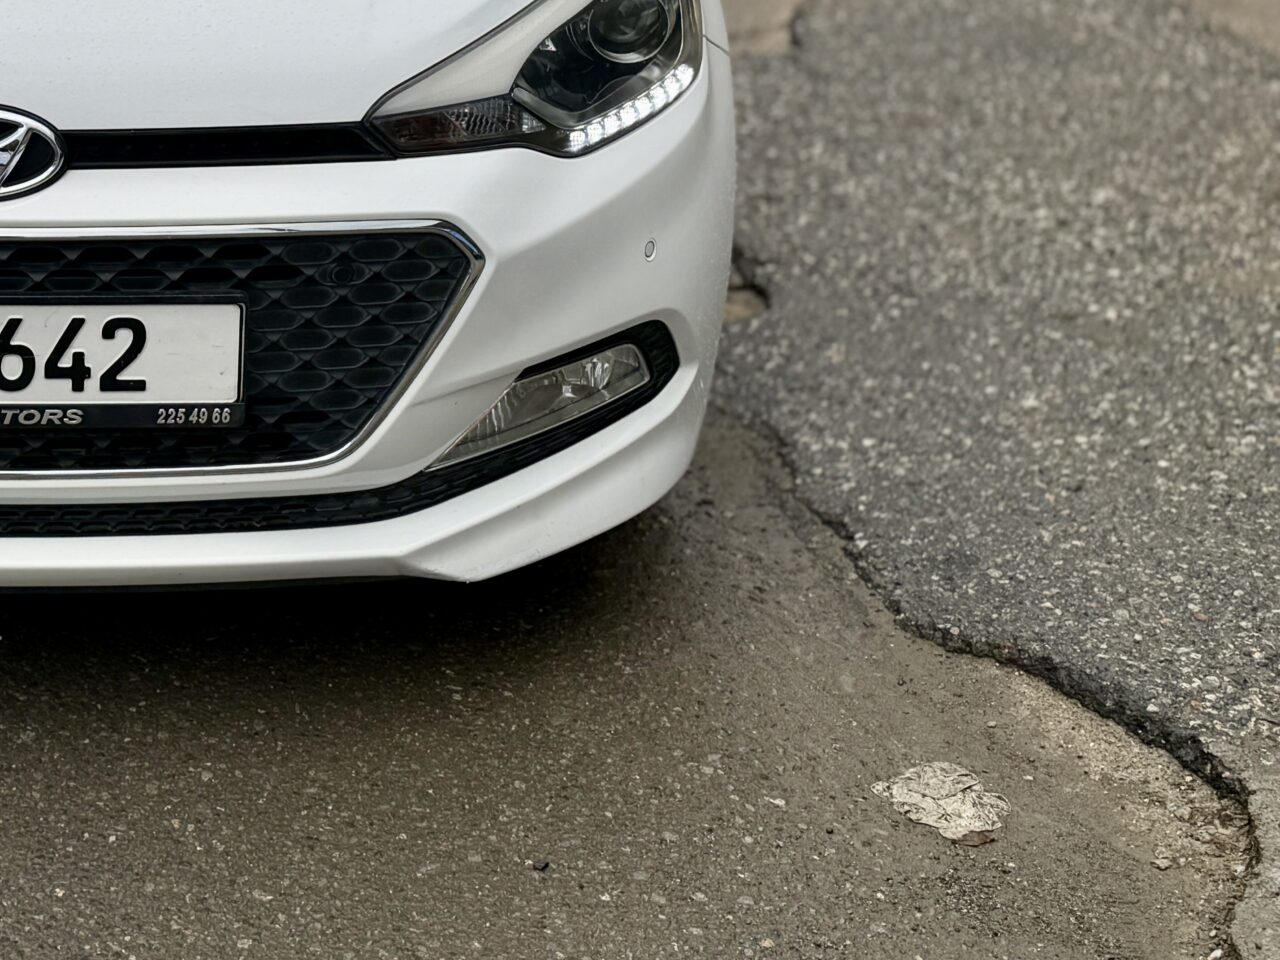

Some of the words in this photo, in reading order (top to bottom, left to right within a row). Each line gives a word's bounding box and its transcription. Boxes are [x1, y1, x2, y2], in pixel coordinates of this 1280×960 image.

[156, 408, 186, 424] 225
[188, 408, 208, 424] 49
[211, 408, 231, 424] 66
